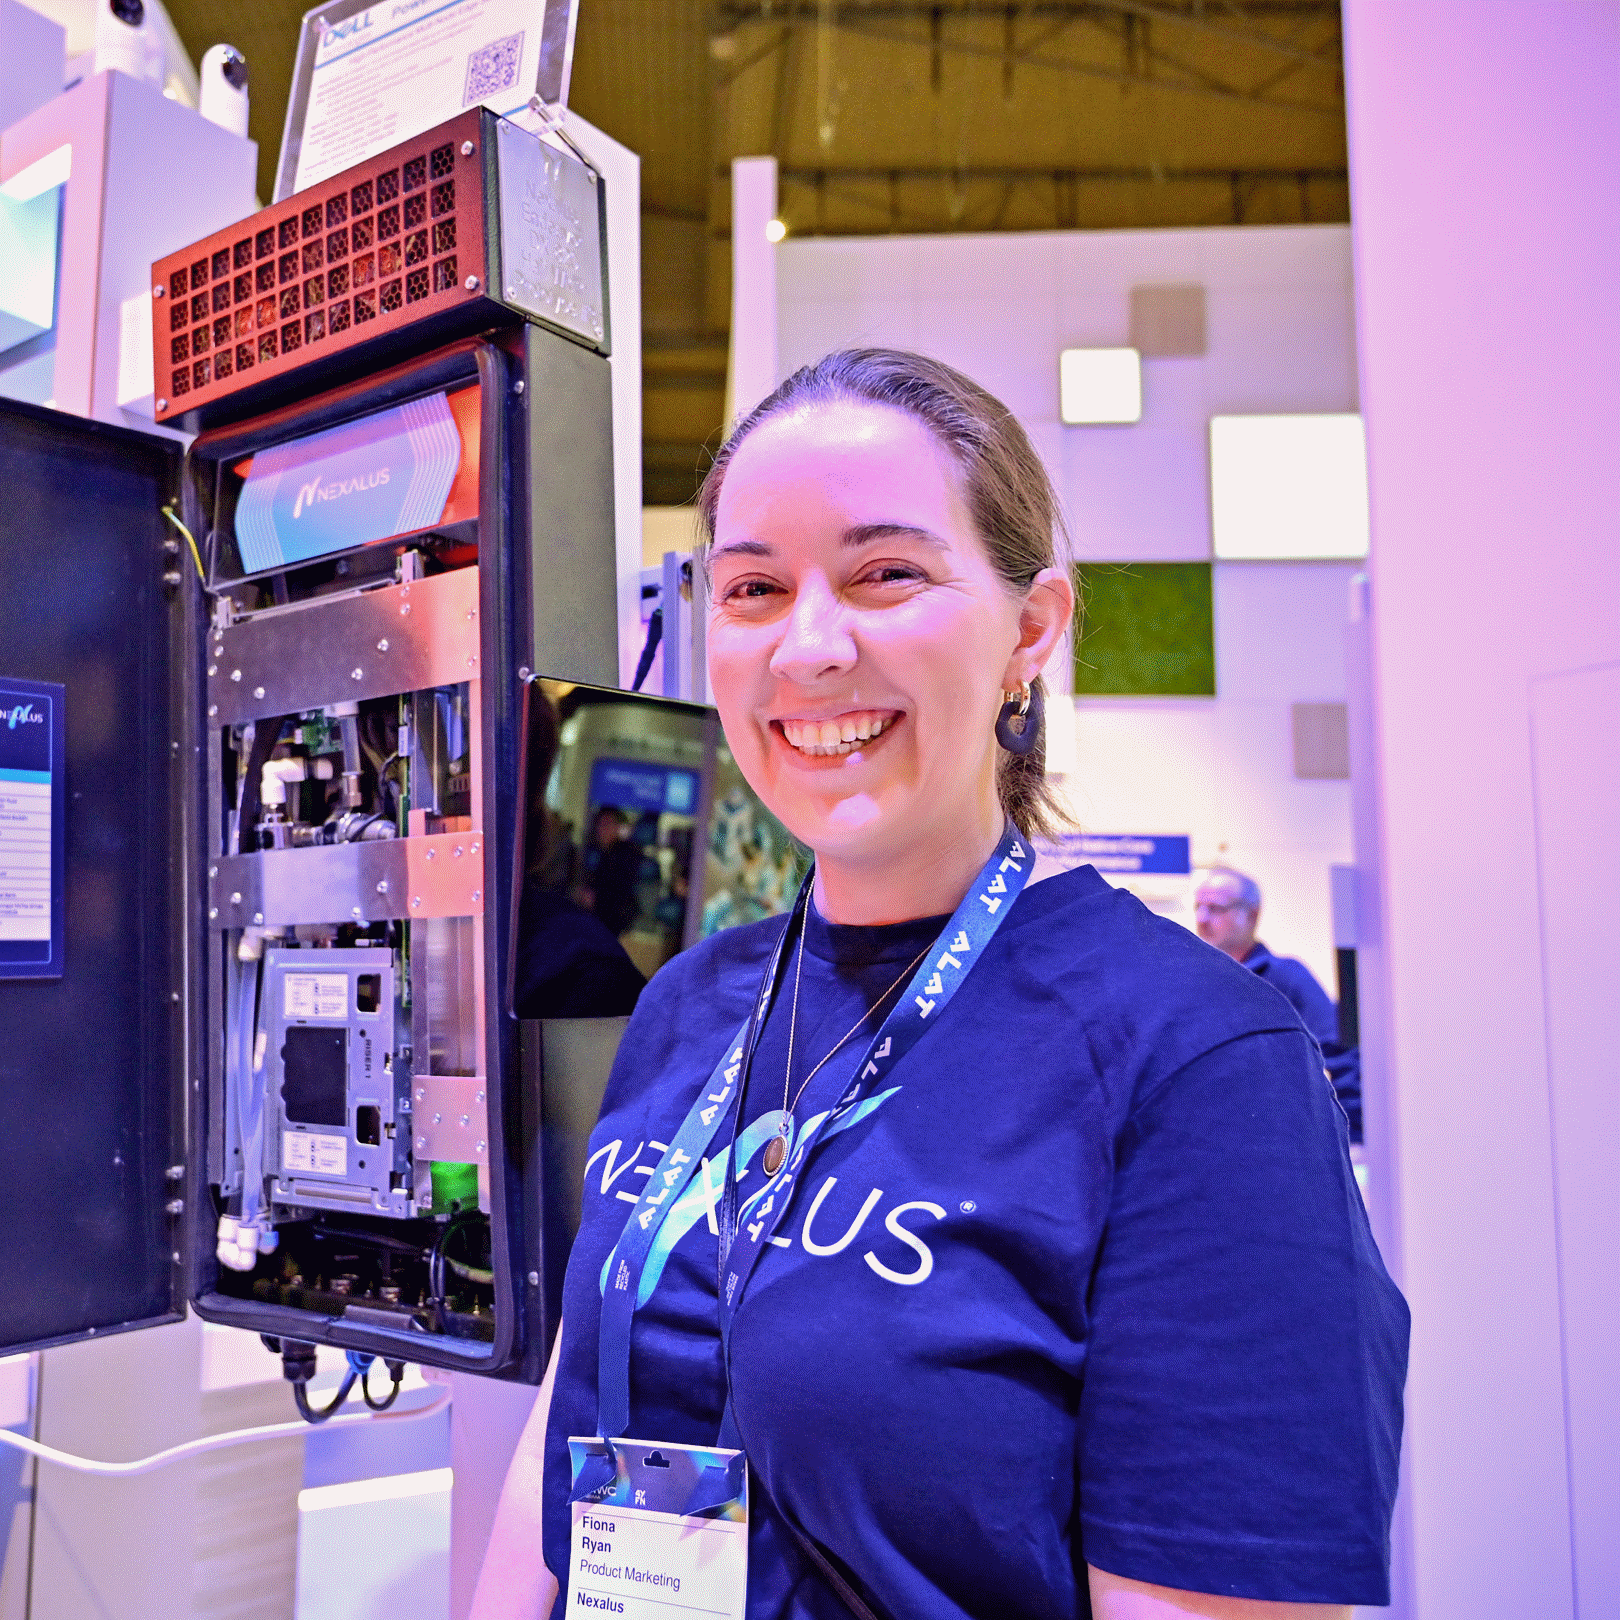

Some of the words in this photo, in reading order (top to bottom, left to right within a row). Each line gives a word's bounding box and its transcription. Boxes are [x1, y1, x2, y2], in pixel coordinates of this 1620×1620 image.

[317, 467, 390, 503] NEXALUS
[979, 841, 1026, 914] ALAT
[914, 931, 970, 1019] ALAT
[638, 1148, 691, 1230] ALAT
[594, 1486, 617, 1497] WC
[582, 1516, 616, 1533] Fiona
[581, 1536, 612, 1553] Ryan
[580, 1559, 622, 1579] Product
[624, 1566, 681, 1592] Marketing
[577, 1591, 624, 1614] Nexalus
